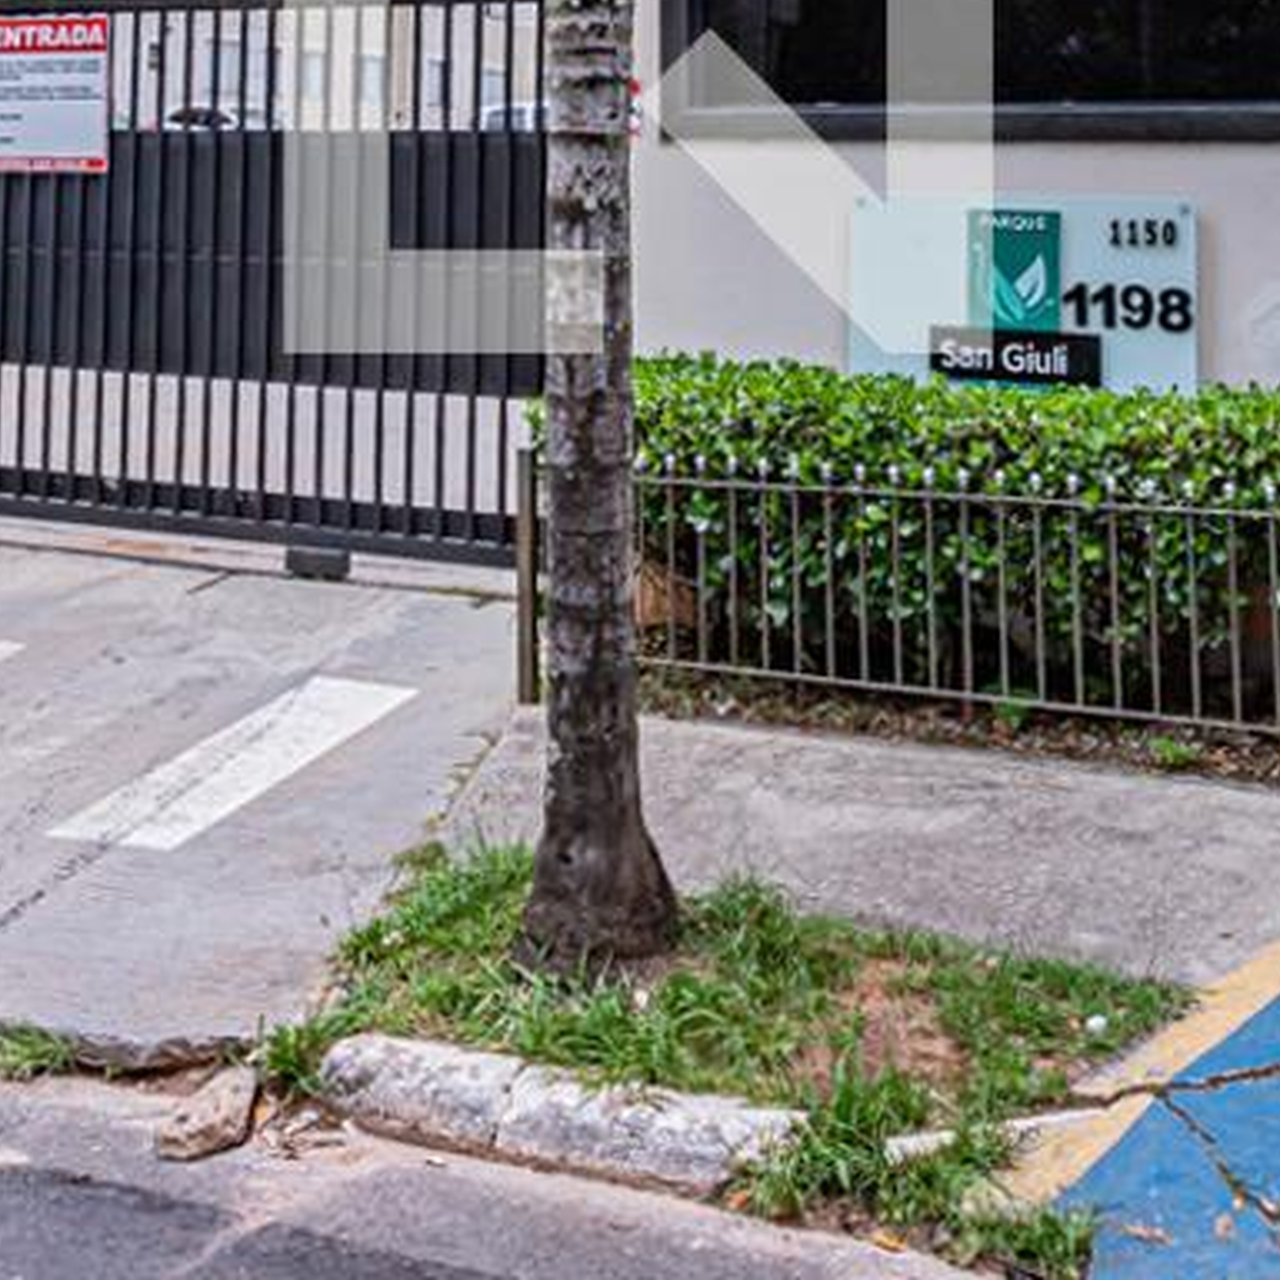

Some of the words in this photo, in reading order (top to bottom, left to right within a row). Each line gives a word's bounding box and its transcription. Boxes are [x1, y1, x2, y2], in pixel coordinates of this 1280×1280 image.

[1110, 221, 1178, 246] 1150
[1063, 282, 1194, 332] 1198
[940, 340, 993, 369] San
